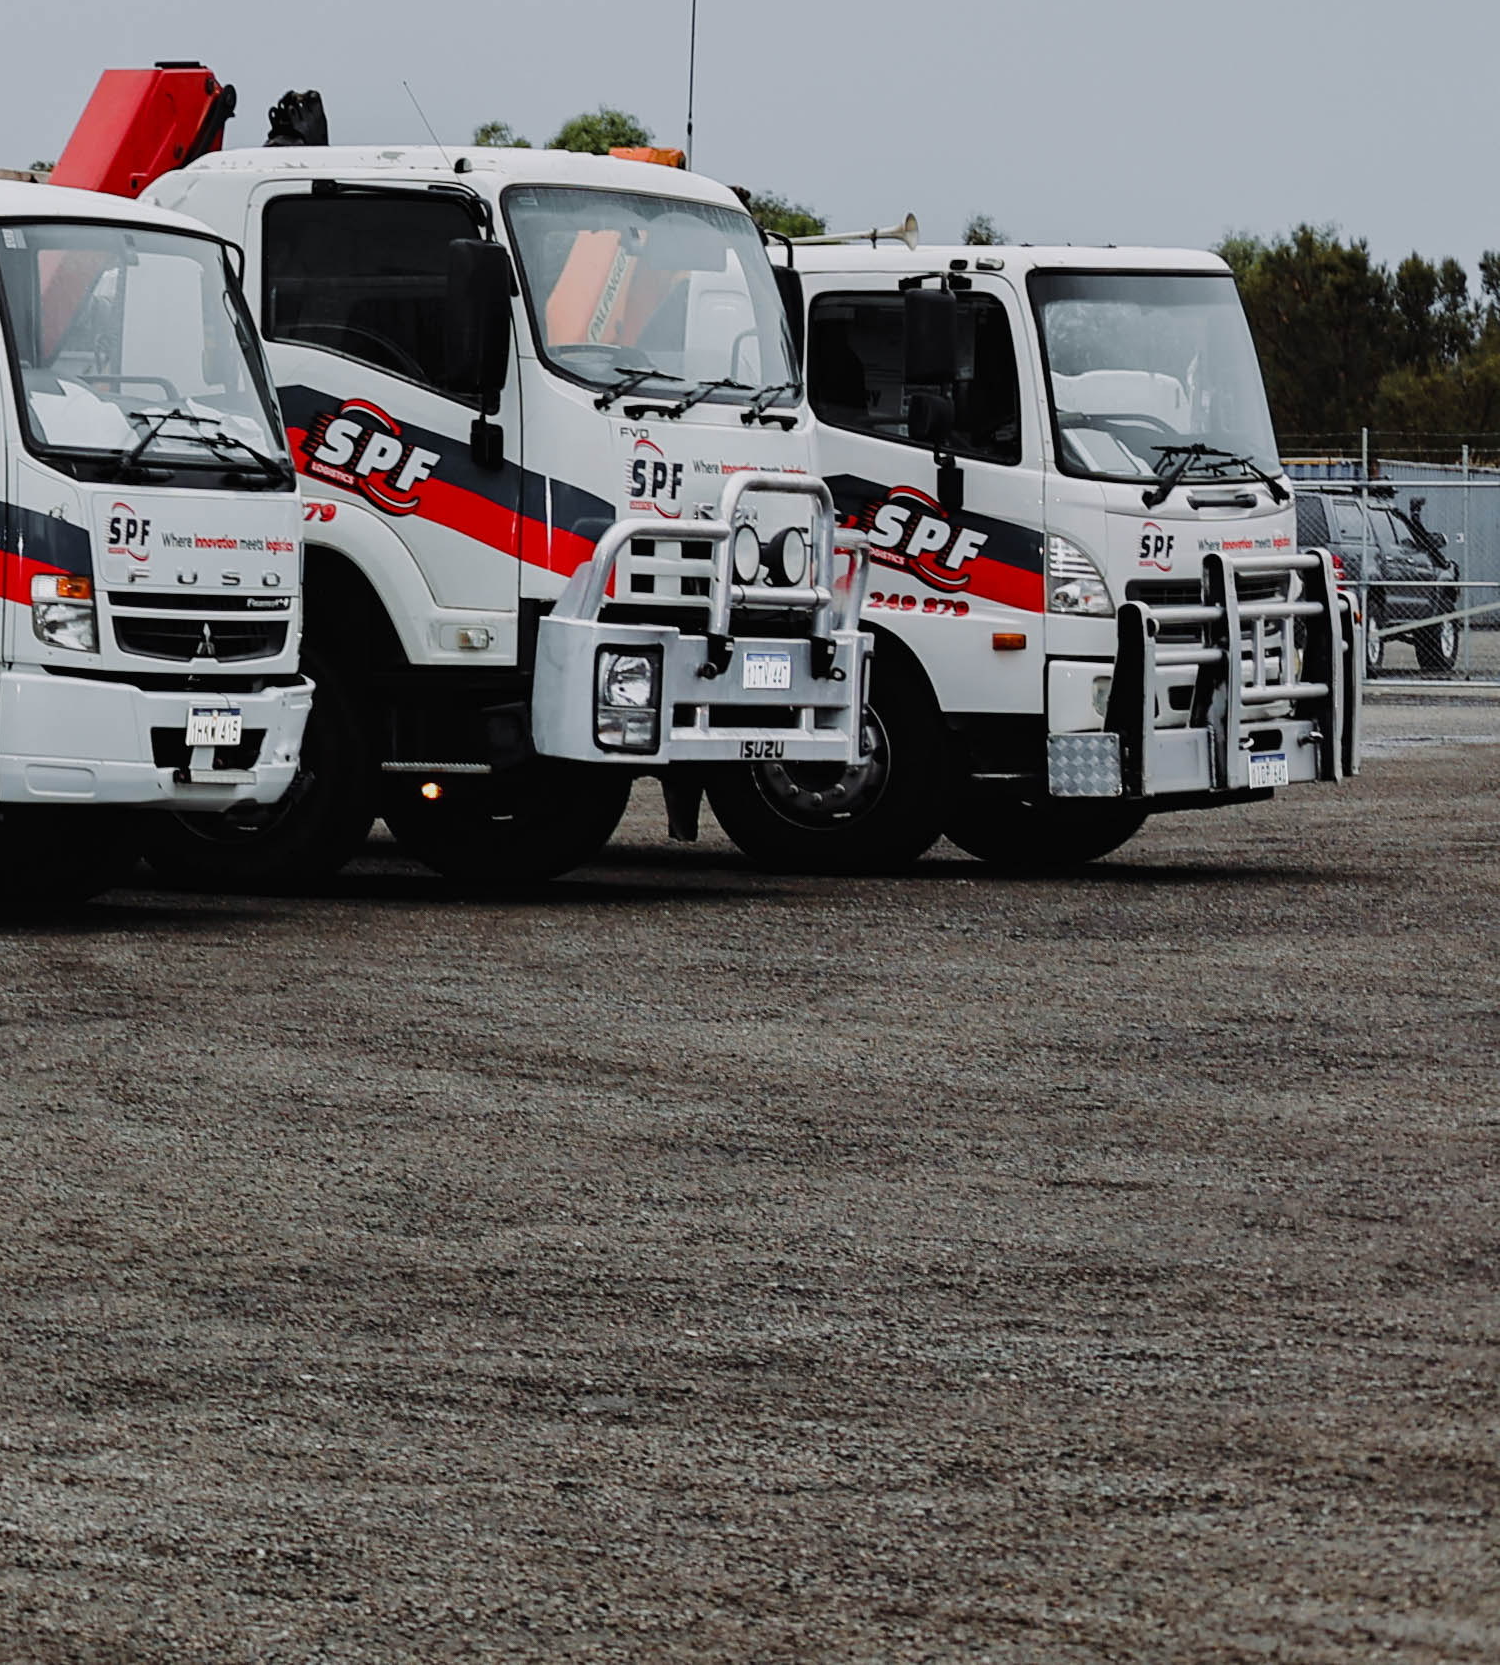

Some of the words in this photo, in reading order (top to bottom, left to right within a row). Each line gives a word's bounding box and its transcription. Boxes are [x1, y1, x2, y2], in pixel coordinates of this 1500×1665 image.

[314, 418, 442, 492] SPF
[692, 458, 720, 475] Where
[311, 461, 356, 485] LOGISTICS
[631, 459, 683, 500] SPF
[302, 502, 337, 522] 79
[108, 517, 151, 547] SPF
[162, 532, 193, 548] Where
[194, 534, 238, 550] innovation
[867, 504, 989, 570] SPF
[868, 545, 906, 566] OGISTICS
[1139, 534, 1175, 559] SPF
[128, 566, 281, 587] FUSO
[868, 591, 917, 611] 249
[922, 596, 971, 617] 879
[739, 740, 785, 759] ISUZU
